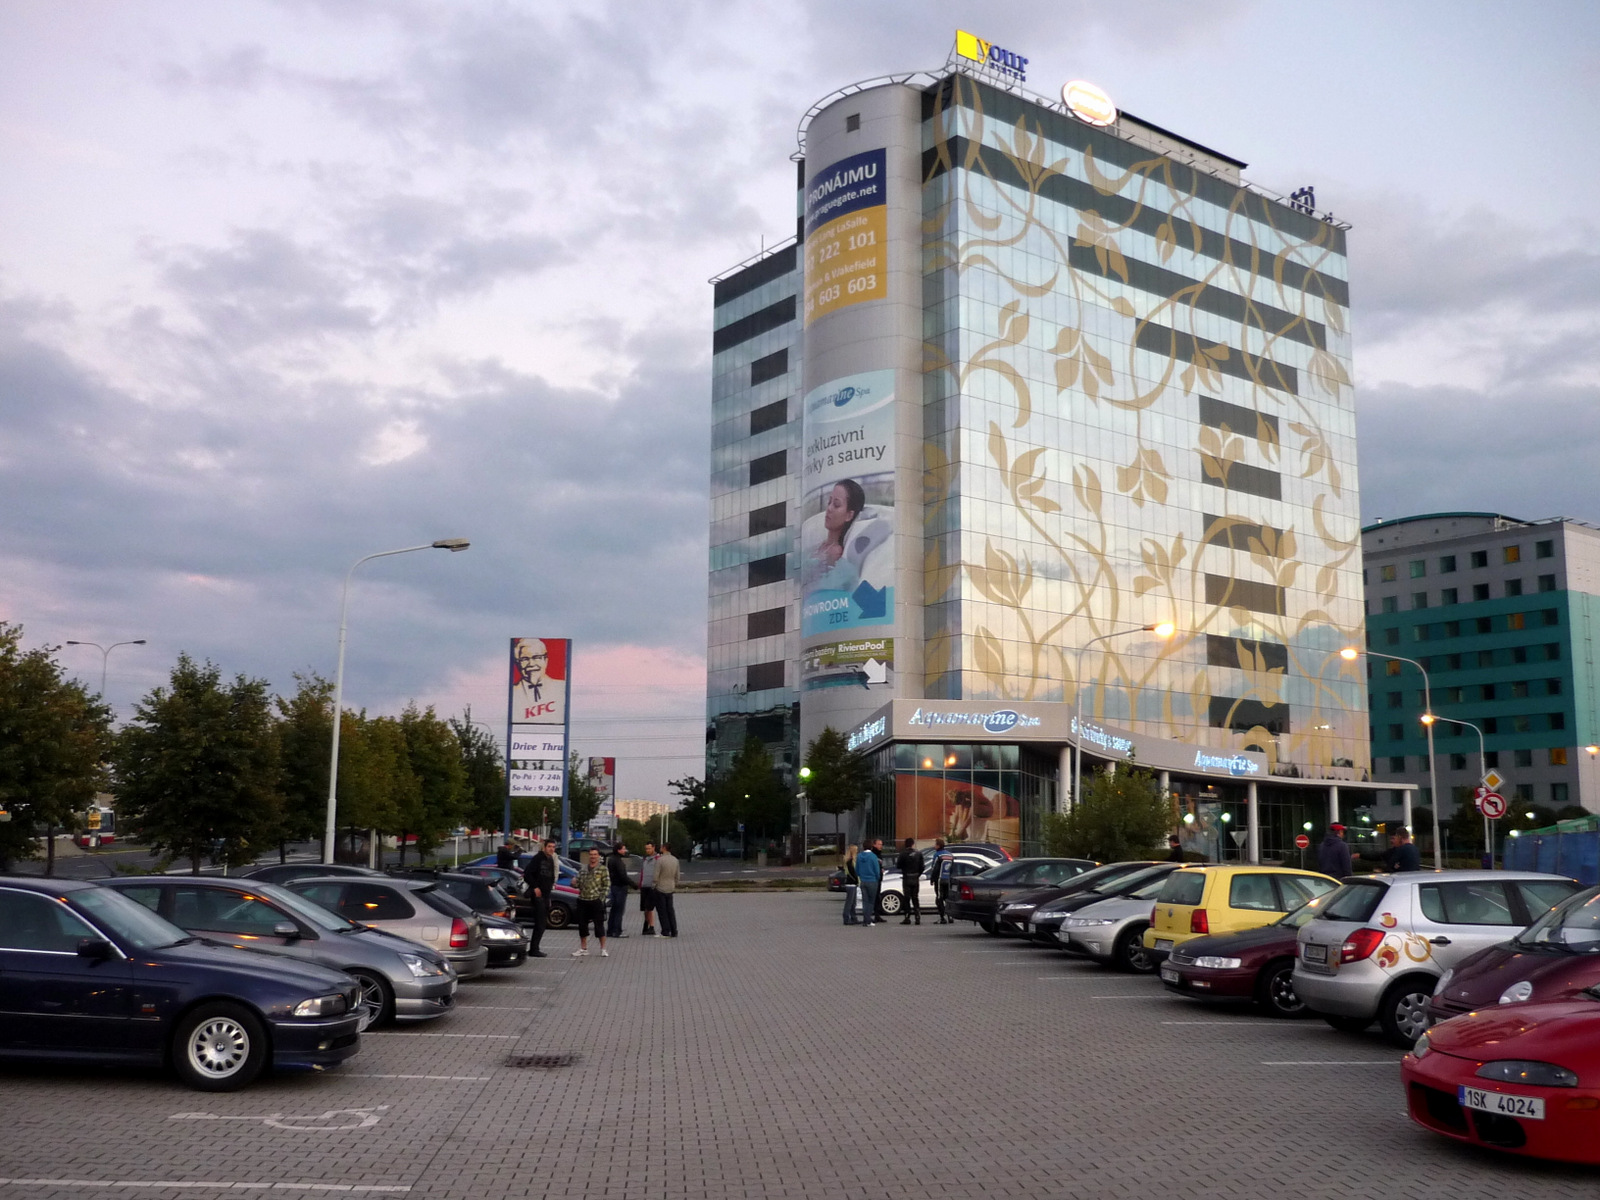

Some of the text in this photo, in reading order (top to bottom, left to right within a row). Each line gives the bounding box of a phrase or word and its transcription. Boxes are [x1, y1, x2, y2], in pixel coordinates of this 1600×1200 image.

[976, 38, 1029, 73] your
[836, 215, 868, 232] LaSalle
[819, 241, 840, 263] 222
[848, 230, 876, 251] 101
[831, 257, 876, 280] Wakefield
[819, 284, 840, 306] 603
[848, 275, 876, 294] 603
[827, 455, 834, 467] a
[838, 445, 886, 463] sauny
[829, 611, 848, 624] ZDE
[838, 640, 885, 652] RivieraPool
[525, 701, 556, 719] KFC
[908, 707, 1041, 730] Aquamarine Spa
[512, 742, 564, 751] Drive Thru
[1467, 1089, 1536, 1116] 1SK 4024
